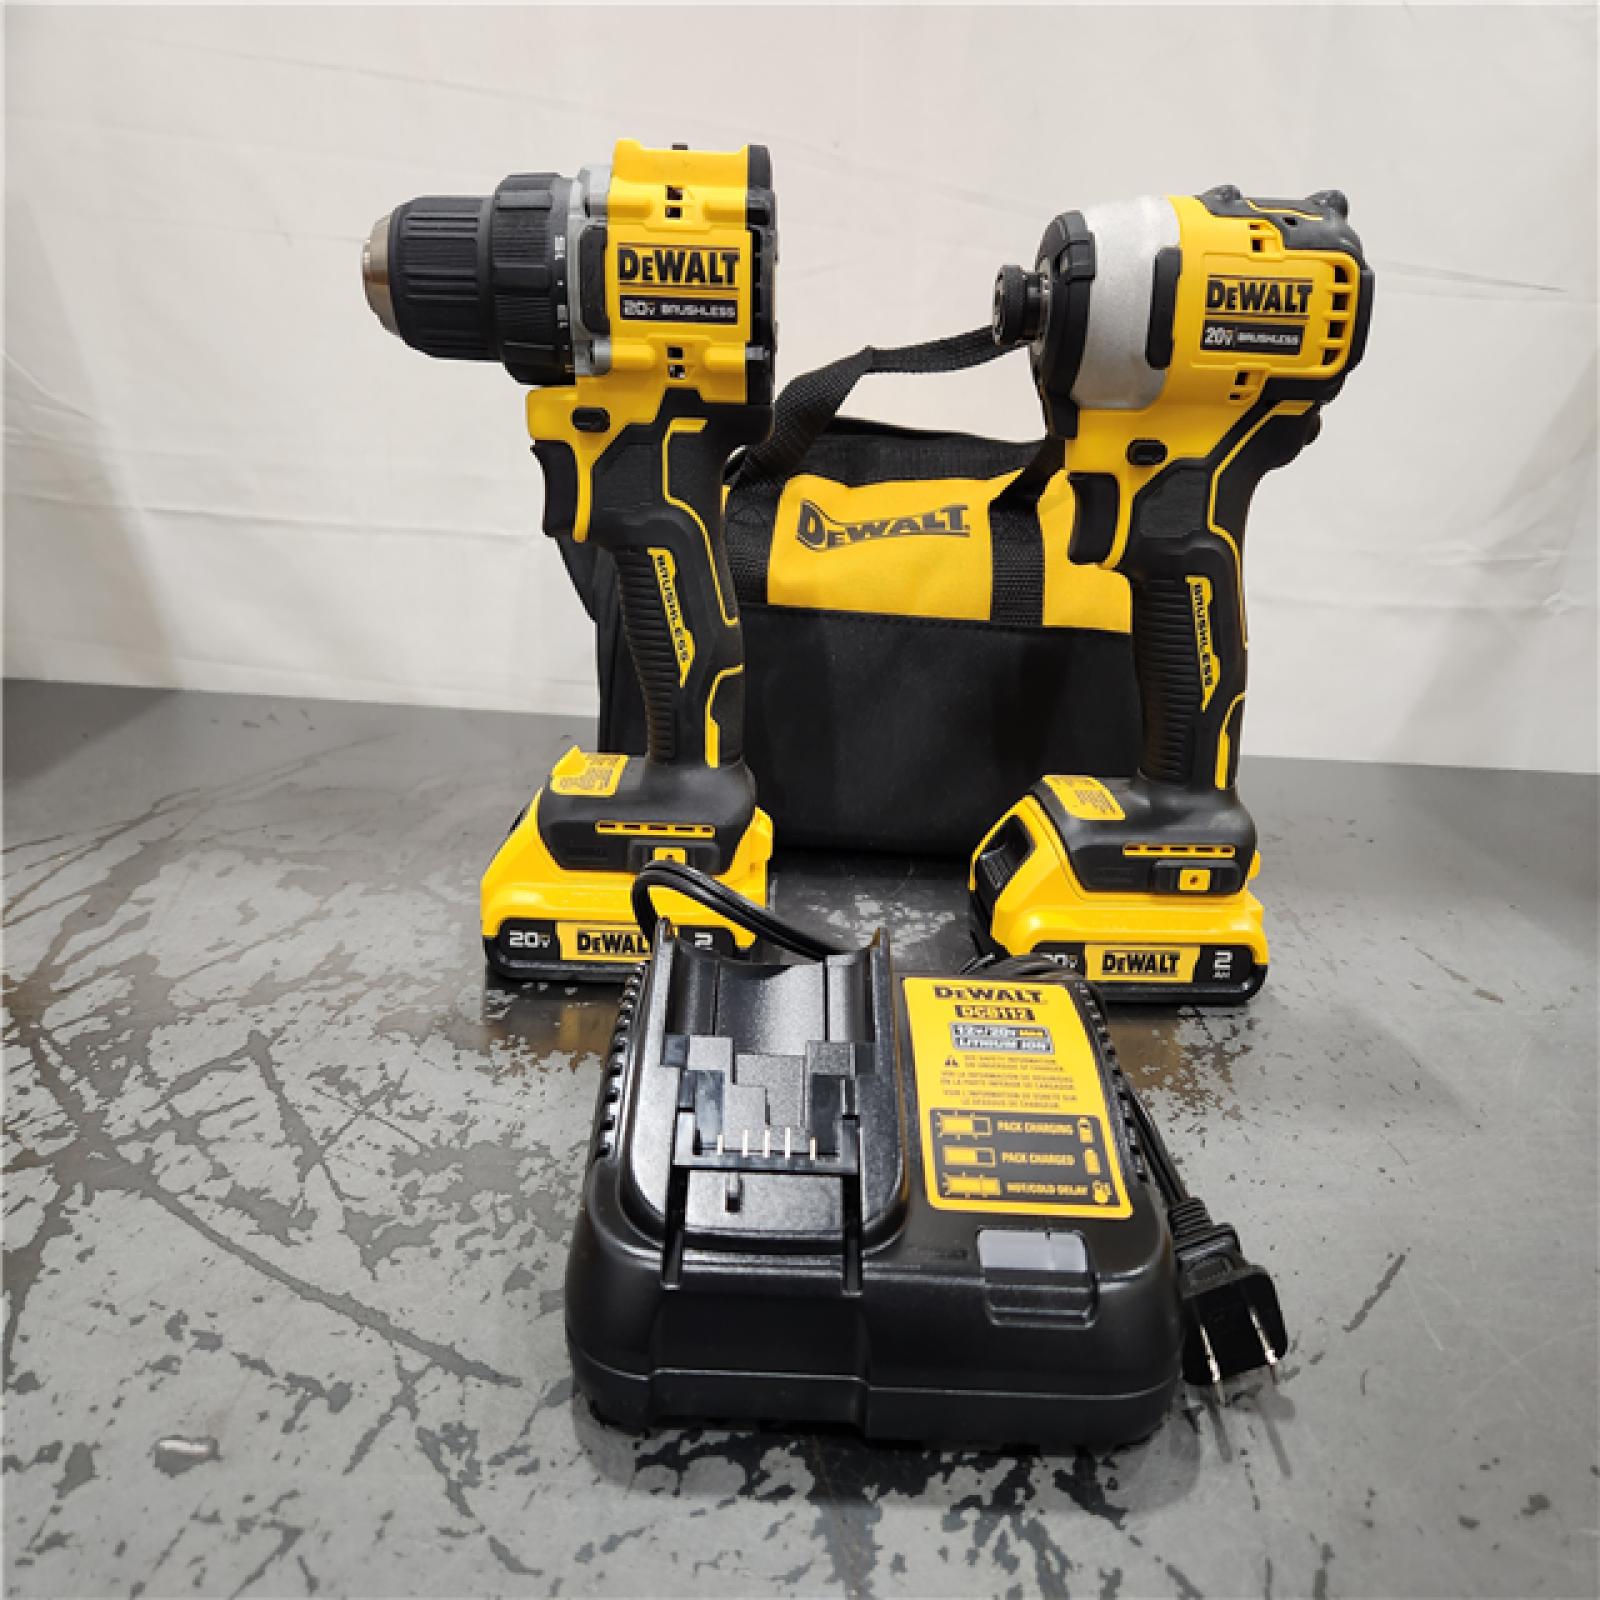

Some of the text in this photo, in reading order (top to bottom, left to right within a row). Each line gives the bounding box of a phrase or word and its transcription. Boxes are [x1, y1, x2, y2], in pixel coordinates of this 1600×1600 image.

[661, 302, 736, 318] BRUSHLESS
[656, 554, 688, 663] BRUSHLESS
[1194, 583, 1213, 686] BRUSHLESS
[578, 933, 650, 952] DEWAL
[1214, 951, 1233, 970] 2
[997, 1120, 1074, 1136] PACK CHARGING
[1002, 1152, 1076, 1166] PACK CHARGED
[1057, 1185, 1089, 1196] DELAY
